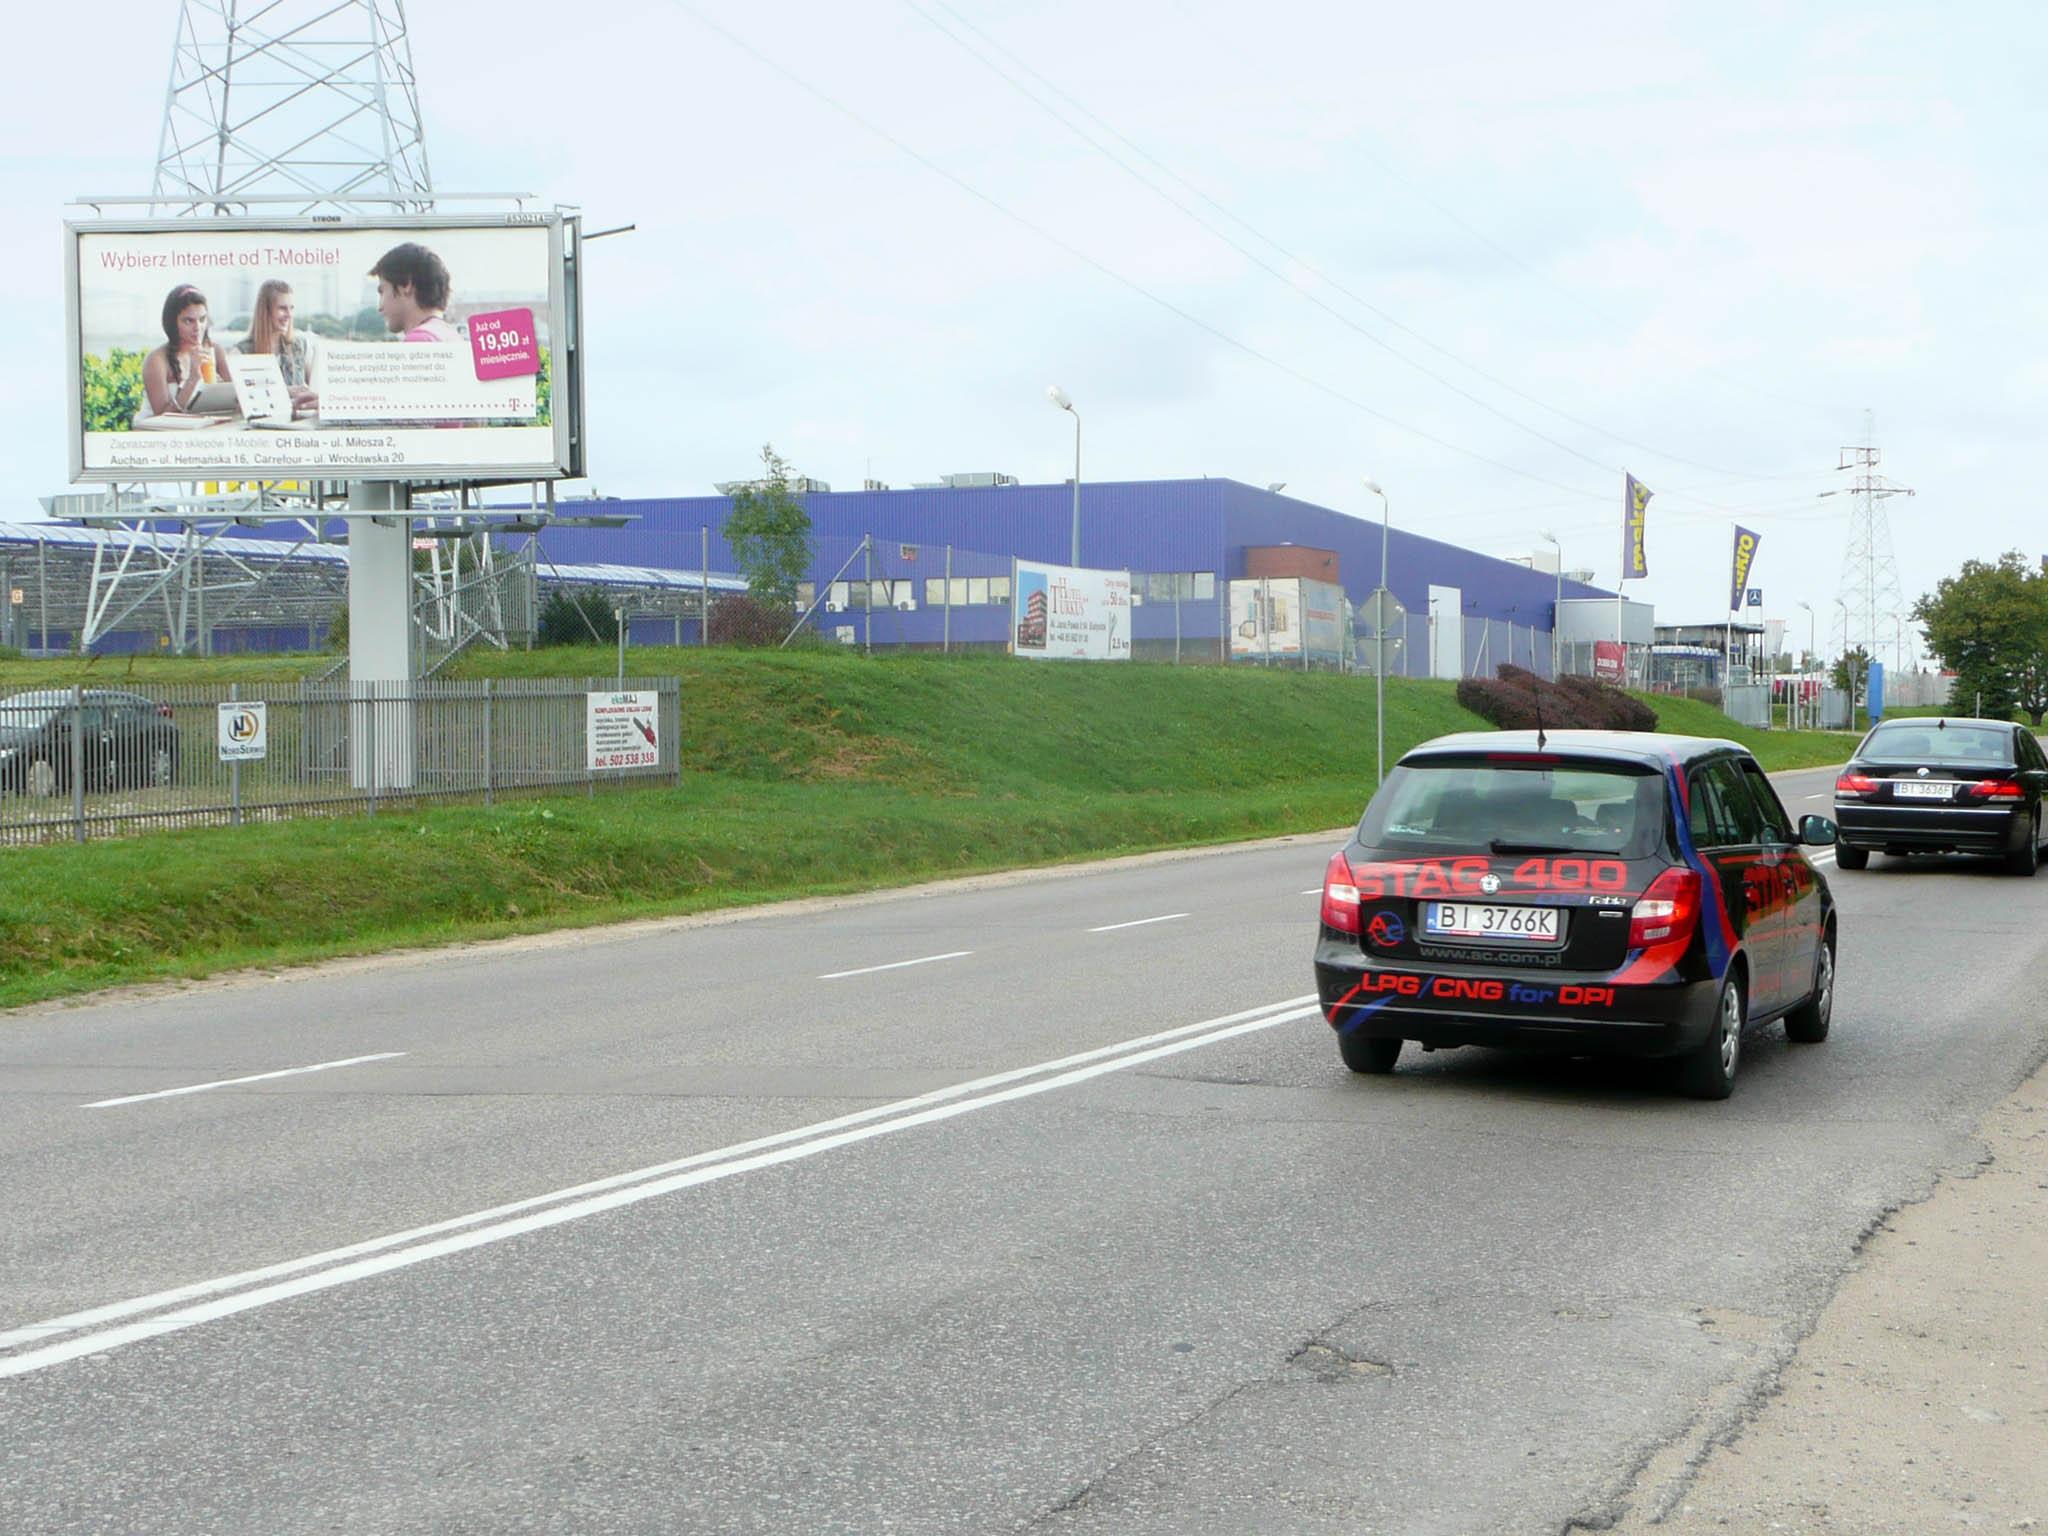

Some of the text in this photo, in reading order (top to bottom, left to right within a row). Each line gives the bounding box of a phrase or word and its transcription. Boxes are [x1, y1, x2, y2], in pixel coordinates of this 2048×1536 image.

[100, 248, 340, 271] Wybierz Internet od T-Mobile!
[489, 320, 501, 329] od
[478, 330, 519, 351] 19,90
[110, 438, 167, 450] Zapraszamy
[170, 439, 182, 449] do
[185, 438, 224, 450] sklepów
[275, 438, 291, 448] CH
[294, 437, 319, 448] Biała
[330, 437, 343, 447] ul.
[346, 437, 384, 448] Miłosza
[110, 455, 148, 465] Auchan
[159, 455, 170, 464] ul.
[174, 454, 231, 465] Hetmańska
[254, 453, 302, 465] Carrefour
[314, 453, 324, 463] ul.
[328, 453, 389, 464] Wrocławska
[391, 452, 404, 463] 20
[610, 754, 624, 766] 502
[1354, 859, 1627, 896] STAG 400
[1482, 908, 1553, 933] 3766K
[1420, 946, 1562, 967] www.ac.com.pl
[1509, 984, 1554, 1003] for
[1558, 985, 1615, 1007] DPI
